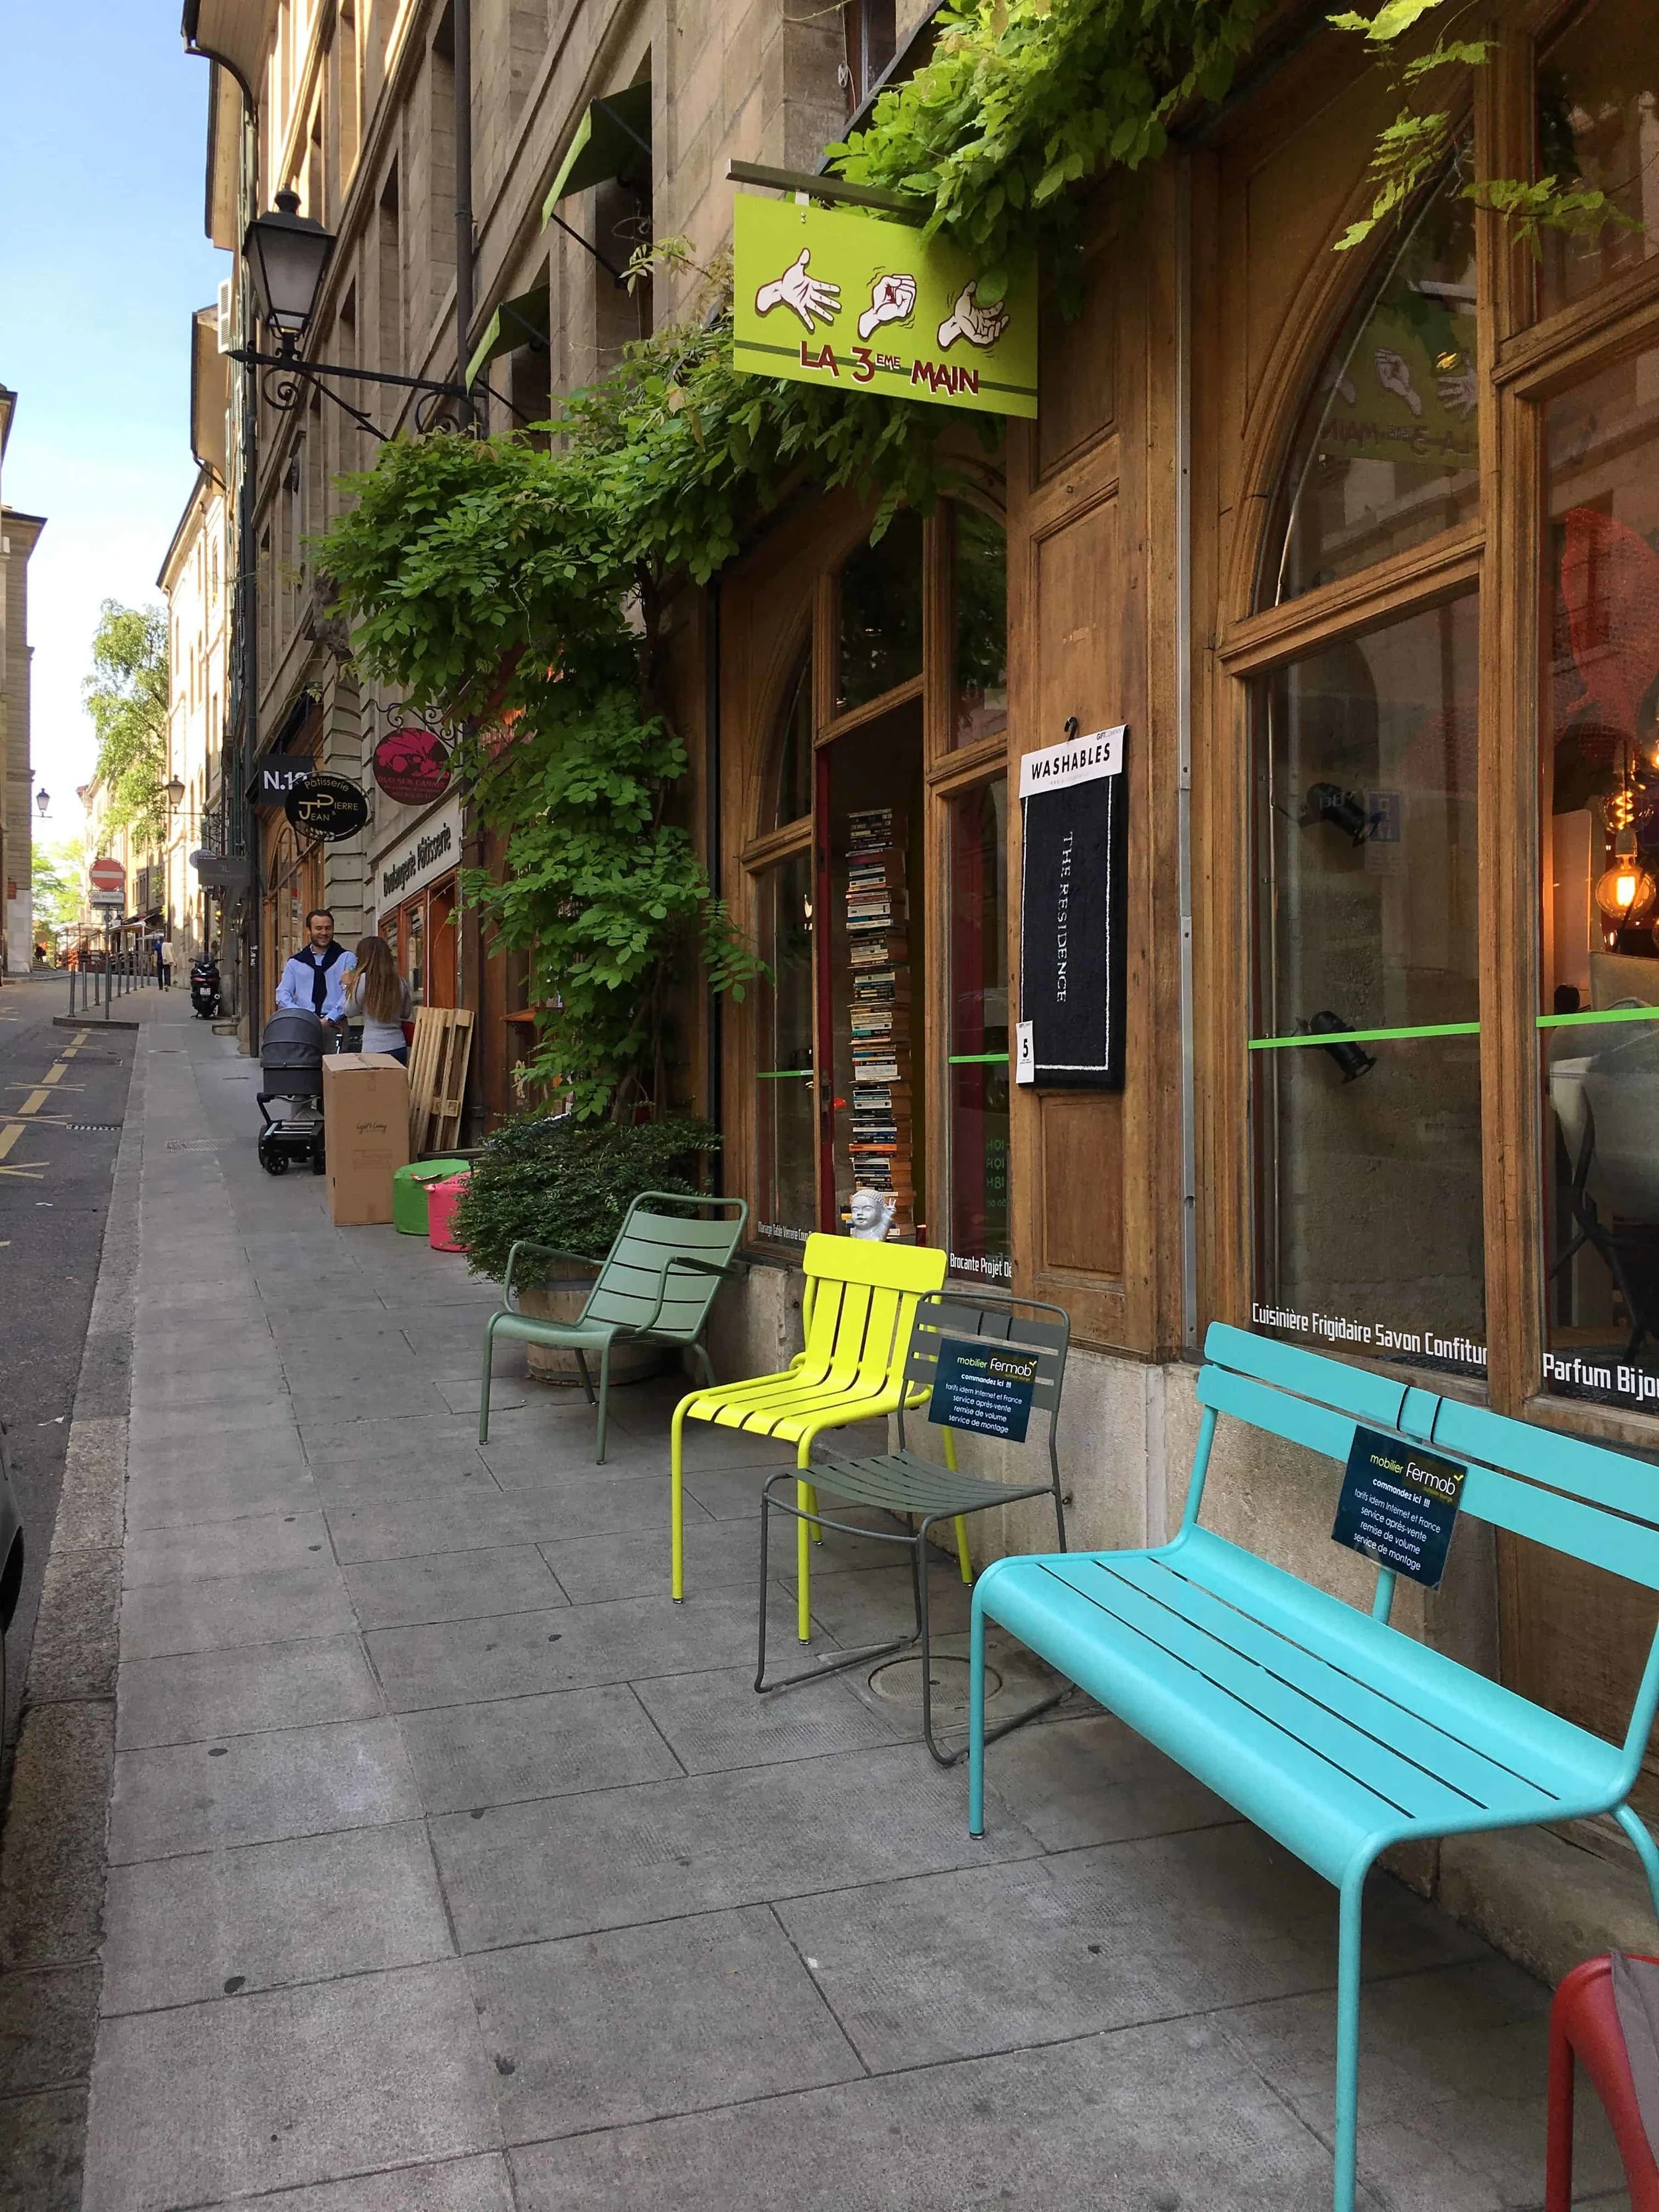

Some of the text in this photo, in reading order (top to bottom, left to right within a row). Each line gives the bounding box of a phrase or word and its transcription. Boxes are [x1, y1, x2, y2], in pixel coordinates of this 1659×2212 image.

[800, 340, 839, 379] LA
[910, 360, 979, 397] MAIN
[1032, 743, 1110, 780] WASHABLES
[299, 800, 330, 822] JEAN
[317, 794, 358, 811] PIERRE
[1056, 831, 1073, 1002] THE RESIDENCE
[1023, 1038, 1029, 1058] 5
[950, 1252, 979, 1272] Brocante
[981, 1257, 1002, 1278] Projet
[1252, 1303, 1308, 1331] Cuisinière
[1312, 1315, 1371, 1343] Frigidaire
[1375, 1323, 1420, 1353] Savon
[957, 1357, 988, 1368] mobilier
[961, 1373, 996, 1385] commandez
[1543, 1353, 1659, 1401] Parfum Bijo
[946, 1382, 958, 1391] tarifs
[959, 1385, 974, 1394] idem
[1003, 1394, 1023, 1404] France
[953, 1394, 1011, 1412] service après-vente
[948, 1414, 1009, 1434] service de montage
[954, 1405, 1007, 1422] remise de volume
[1370, 1454, 1404, 1475] mobilier
[1372, 1478, 1411, 1501] commandez
[1412, 1495, 1421, 1504] ici
[1354, 1488, 1441, 1534] tarifs idem Internet et France
[1360, 1506, 1427, 1542] service après-vente
[1360, 1520, 1421, 1554] remise de volume
[1354, 1532, 1421, 1571] service de montage
